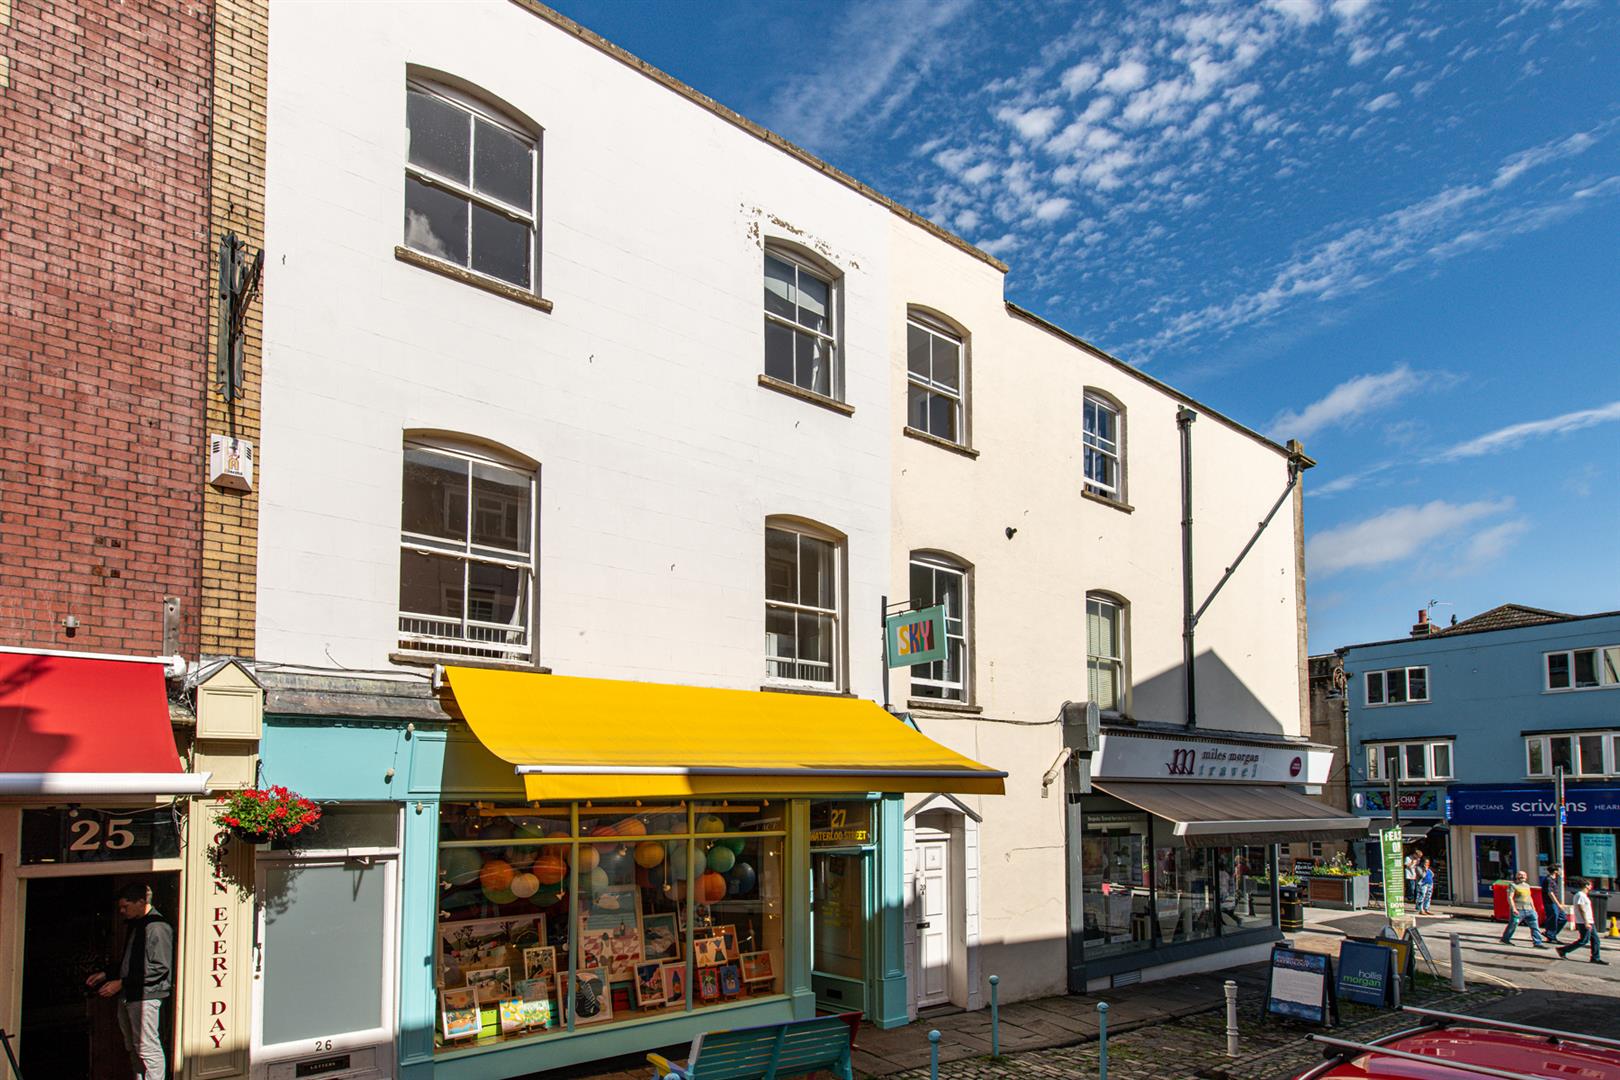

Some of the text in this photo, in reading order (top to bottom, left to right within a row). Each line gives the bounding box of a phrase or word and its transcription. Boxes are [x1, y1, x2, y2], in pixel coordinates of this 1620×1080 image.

[898, 620, 931, 655] SKY
[1201, 748, 1260, 765] miles morgan
[1199, 764, 1258, 778] travel
[1511, 799, 1588, 813] scrivns
[831, 809, 848, 828] 27
[70, 819, 135, 851] 25
[810, 830, 867, 841] WATERLOO STREET
[211, 907, 228, 988] EVERY
[1344, 975, 1381, 987] morgan
[1358, 970, 1383, 981] hollis
[209, 1001, 227, 1049] DAY
[315, 1039, 332, 1052] 26
